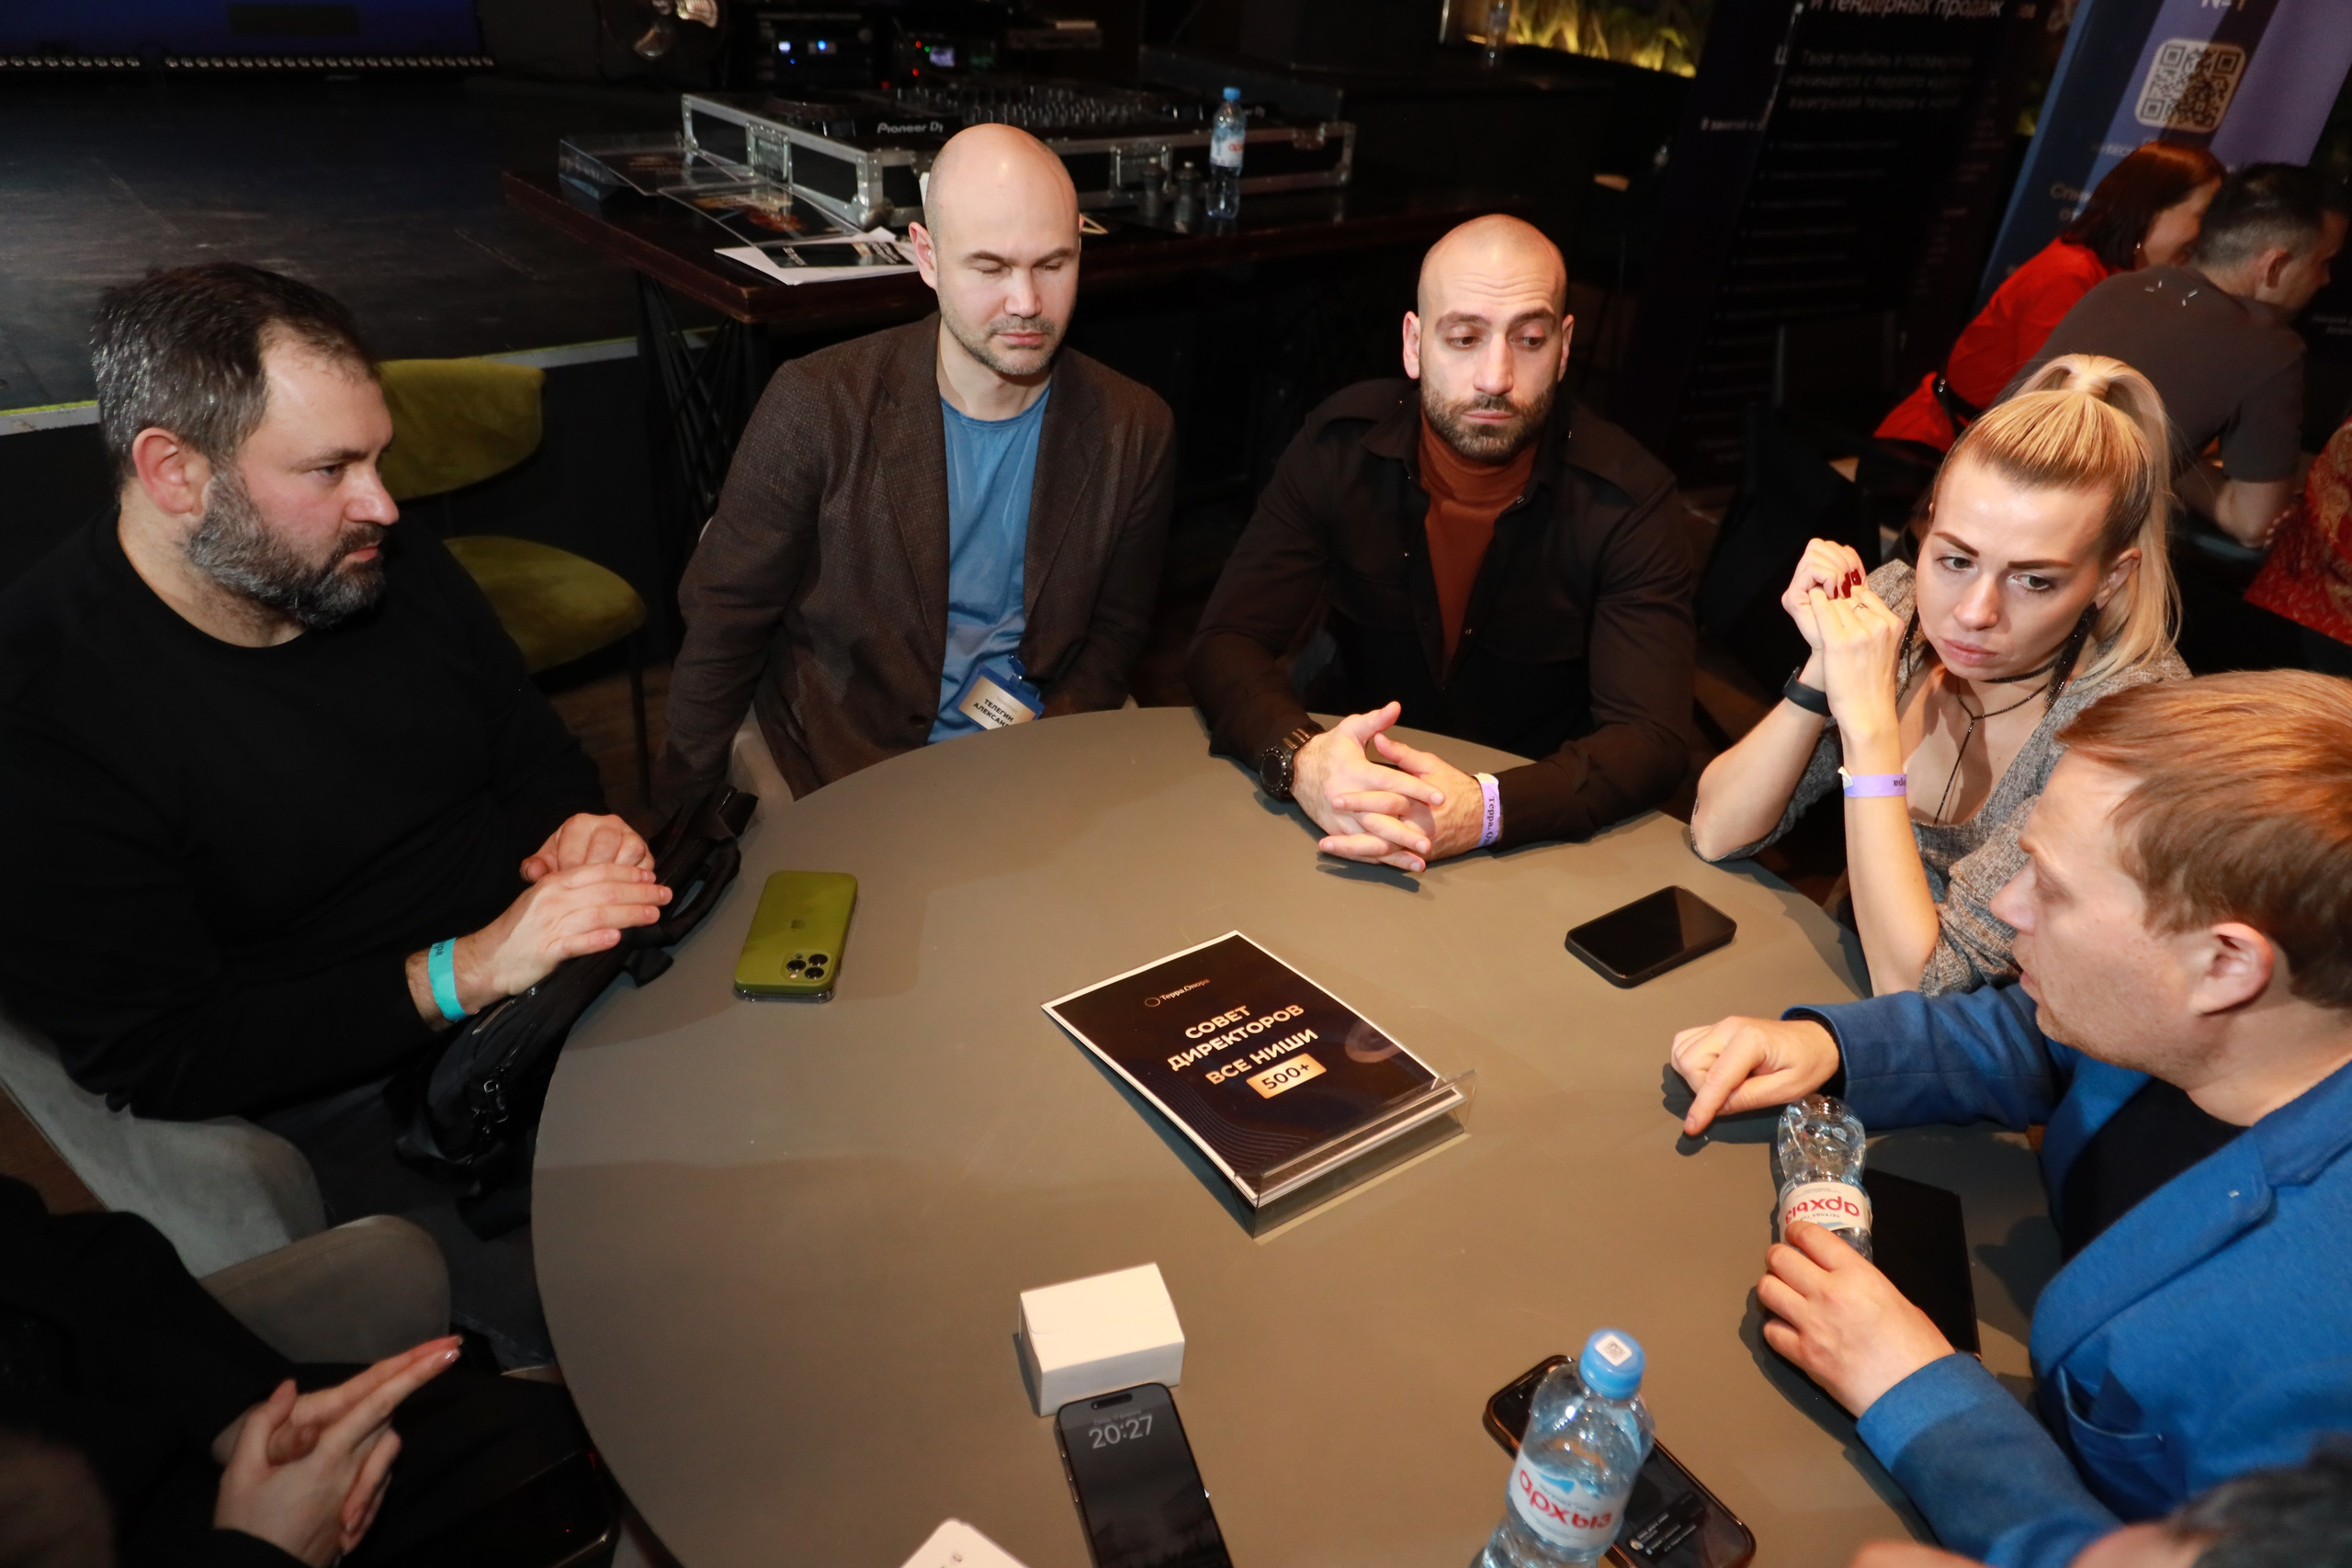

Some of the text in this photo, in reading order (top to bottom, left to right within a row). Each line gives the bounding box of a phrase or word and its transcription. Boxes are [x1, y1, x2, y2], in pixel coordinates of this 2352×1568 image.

[1935, 0, 2004, 20] продаж
[876, 121, 928, 134] Pioneer
[985, 699, 1013, 722] ТЕЛЕГИН
[1167, 1004, 1305, 1072] ДИРЕКТОРОВ
[1184, 1005, 1251, 1039] СОВЕТ
[1204, 1028, 1318, 1085] ВСЕ НИШИ
[1261, 1064, 1309, 1089] 500+
[1785, 1195, 1860, 1225] архыз
[1089, 1414, 1153, 1450] 20:27
[1519, 1469, 1613, 1529] архыз
